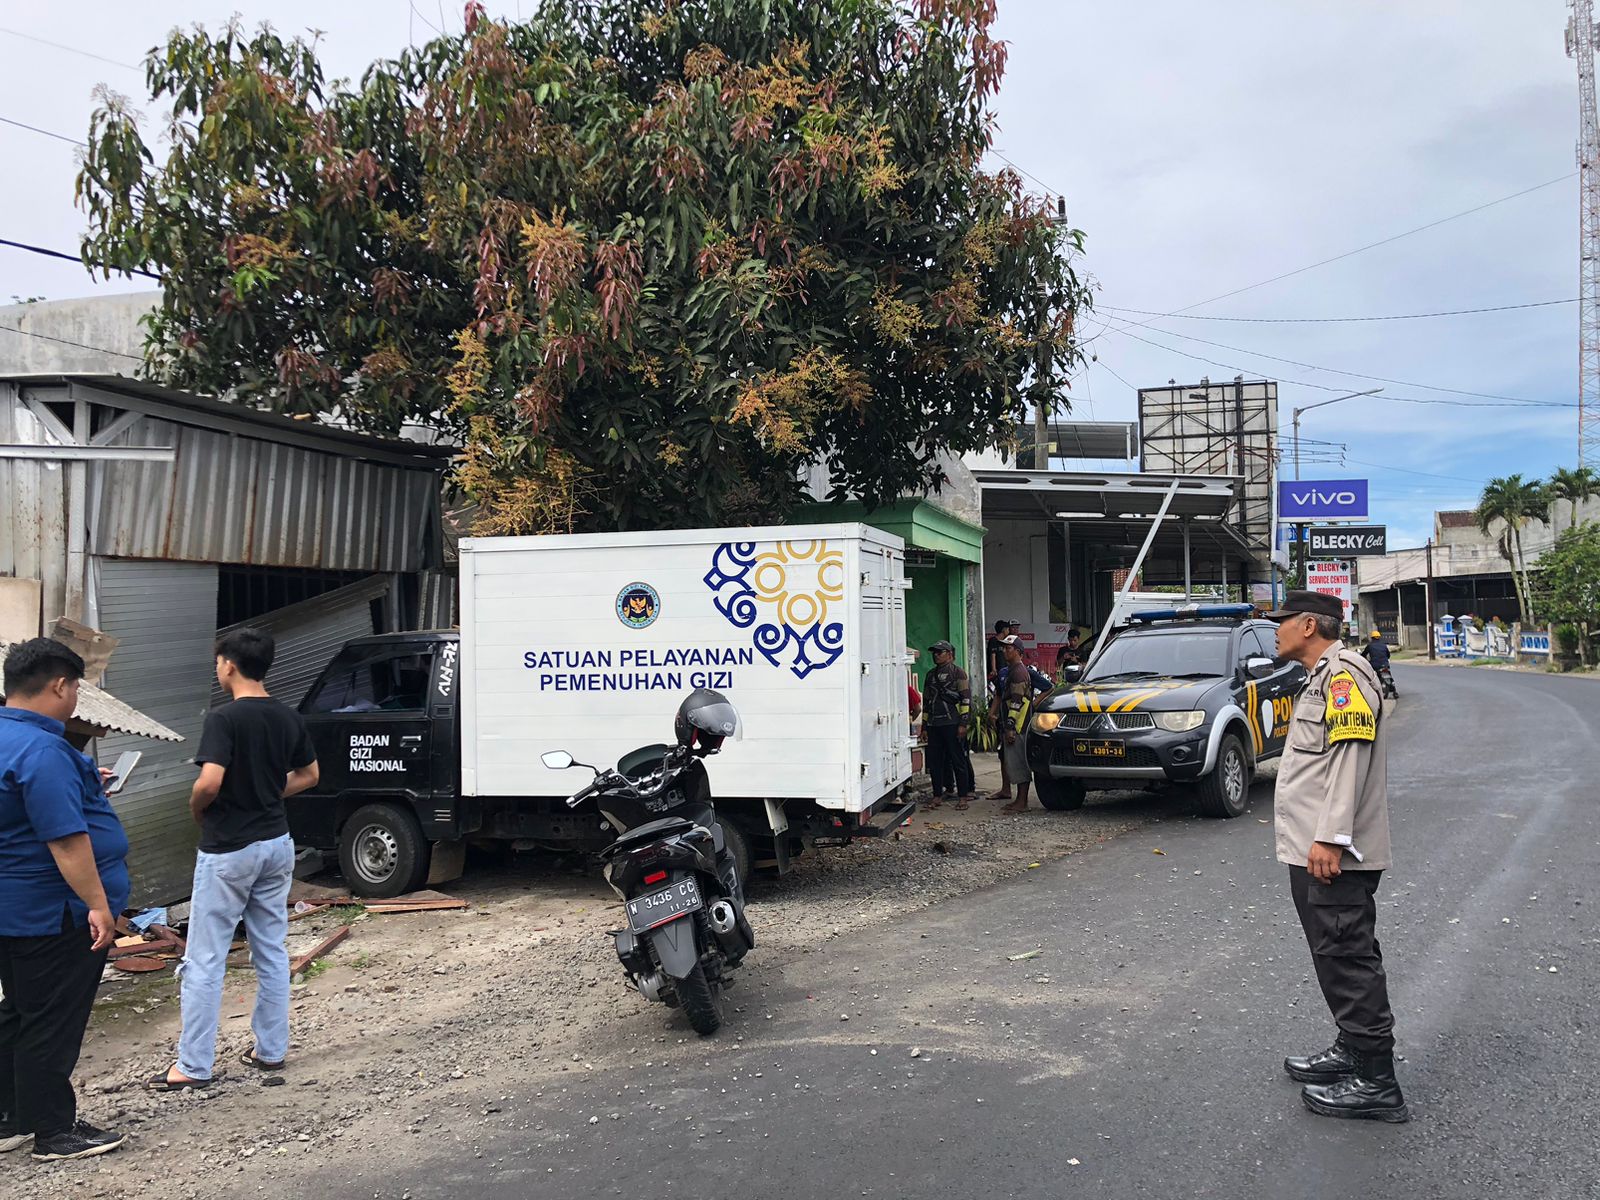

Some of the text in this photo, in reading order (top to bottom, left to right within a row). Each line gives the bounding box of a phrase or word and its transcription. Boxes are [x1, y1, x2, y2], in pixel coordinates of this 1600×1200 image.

[1291, 488, 1356, 505] vivo
[1312, 534, 1384, 549] BLECKY Cell
[1316, 563, 1340, 572] BLECKY
[1308, 575, 1349, 584] SERVICE CENTER
[523, 647, 753, 669] SATUAN PELAYANAN
[540, 671, 733, 691] PEMENUHAN GIZI
[350, 735, 390, 747] BADAN
[350, 748, 372, 760] GIZI
[350, 760, 407, 772] NASIONAL
[630, 902, 638, 915] N
[645, 891, 672, 908] 3436
